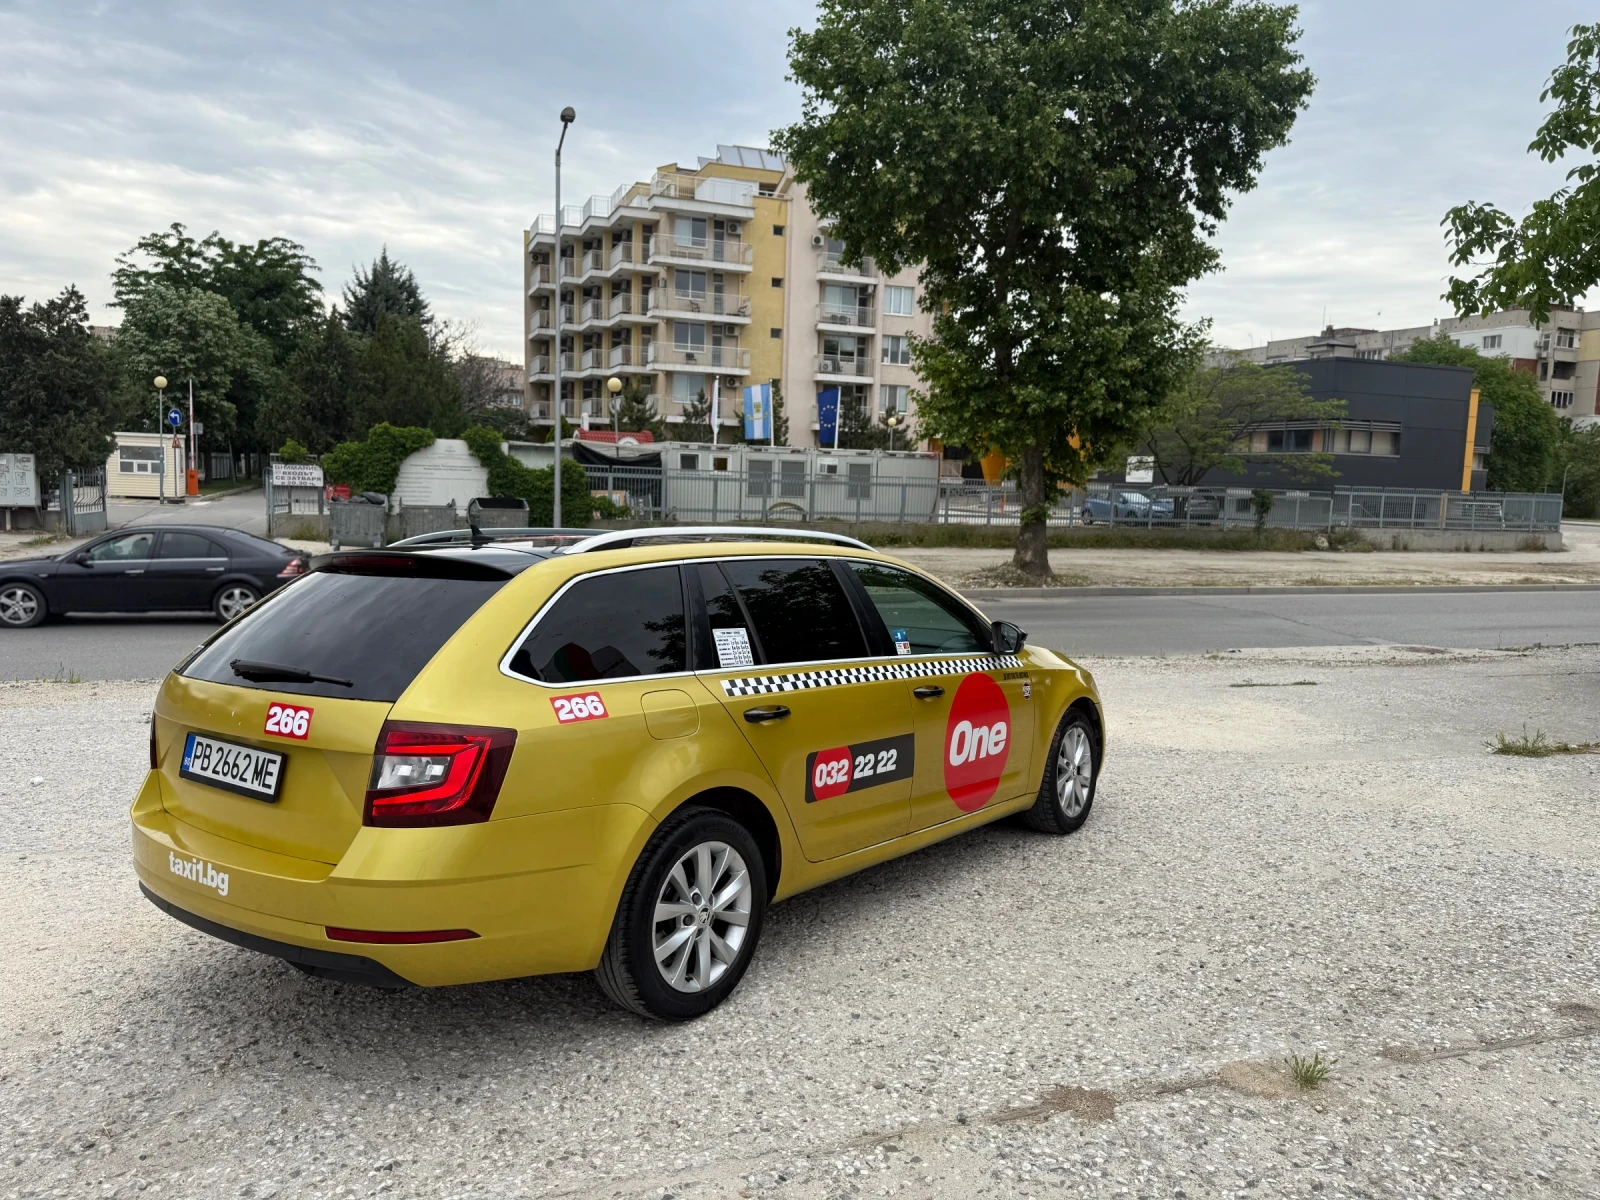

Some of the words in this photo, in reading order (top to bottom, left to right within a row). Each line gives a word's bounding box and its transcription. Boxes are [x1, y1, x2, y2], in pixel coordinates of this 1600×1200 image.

[266, 707, 310, 736] 266
[554, 695, 604, 720] 266
[949, 721, 1008, 766] One
[212, 746, 251, 783] 2662
[815, 759, 849, 788] 032
[853, 753, 875, 780] 22
[876, 748, 898, 774] 22
[168, 851, 229, 897] taxi1.bg
